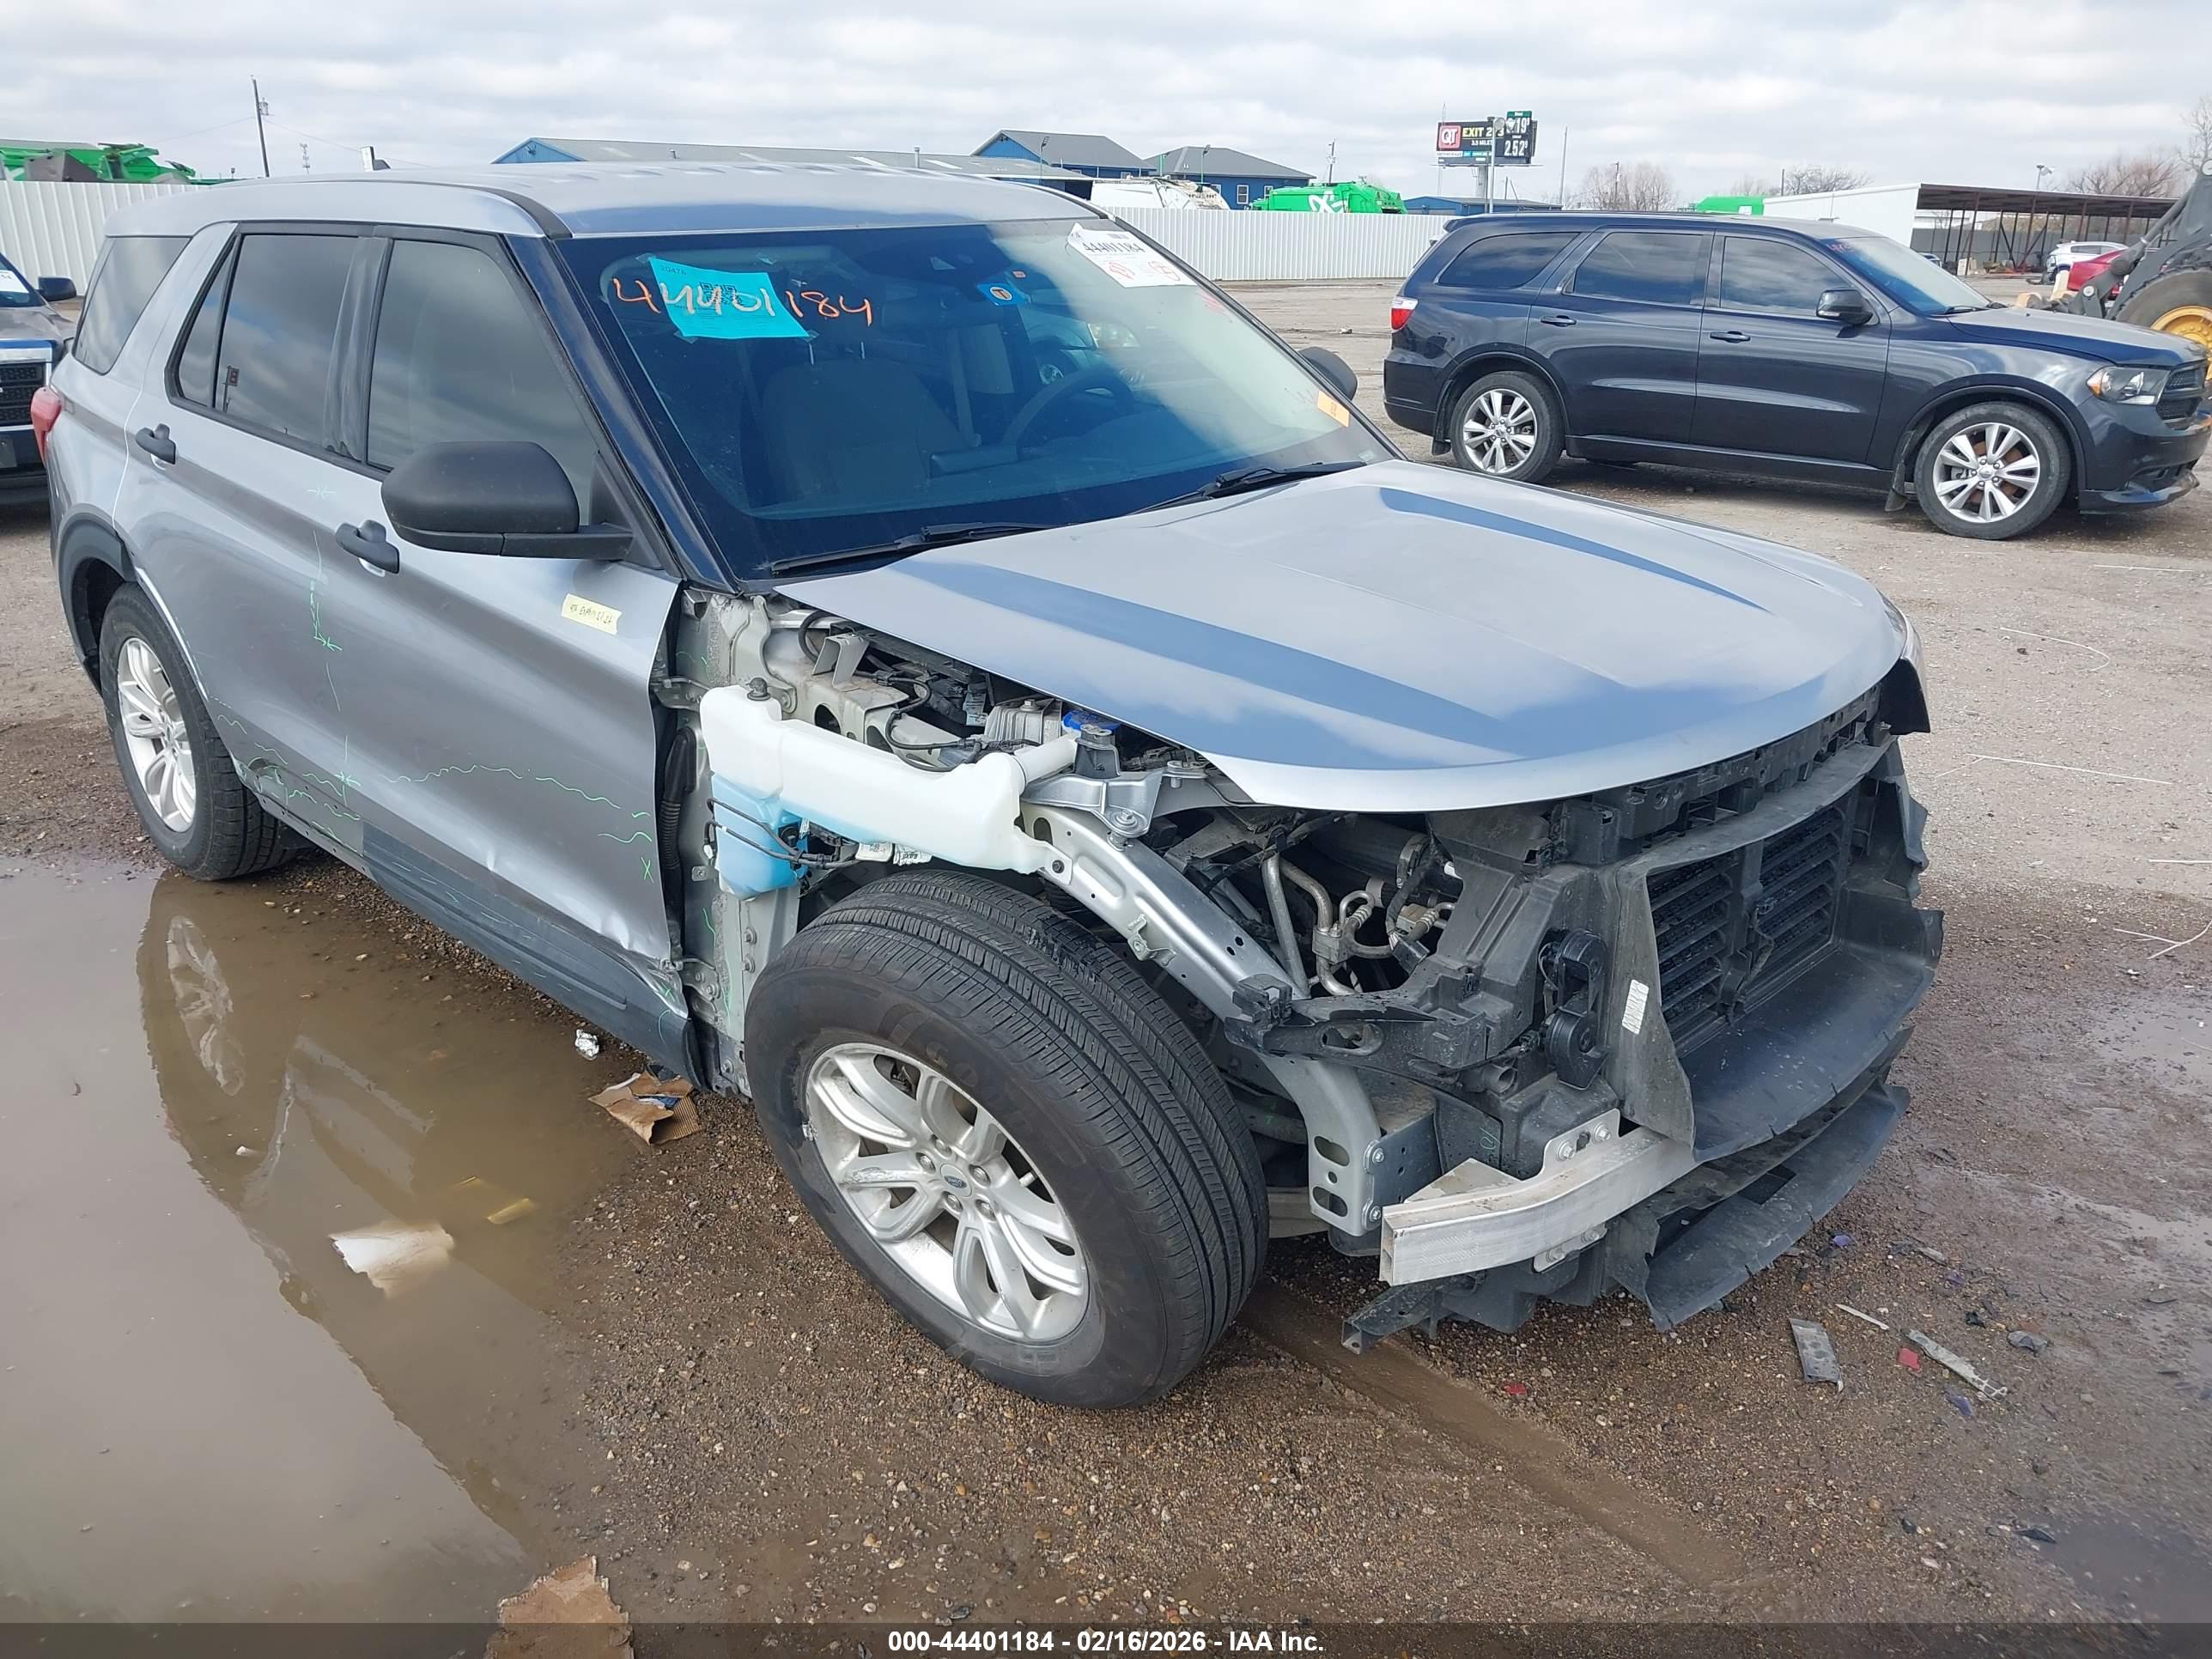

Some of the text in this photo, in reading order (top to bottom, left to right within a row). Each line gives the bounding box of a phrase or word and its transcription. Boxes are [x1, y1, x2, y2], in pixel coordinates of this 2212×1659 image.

[1441, 128, 1458, 145] QT
[1462, 127, 1484, 137] EXIT
[1486, 126, 1504, 137] 23
[1082, 241, 1146, 253] 44401184
[611, 277, 874, 327] 44401184
